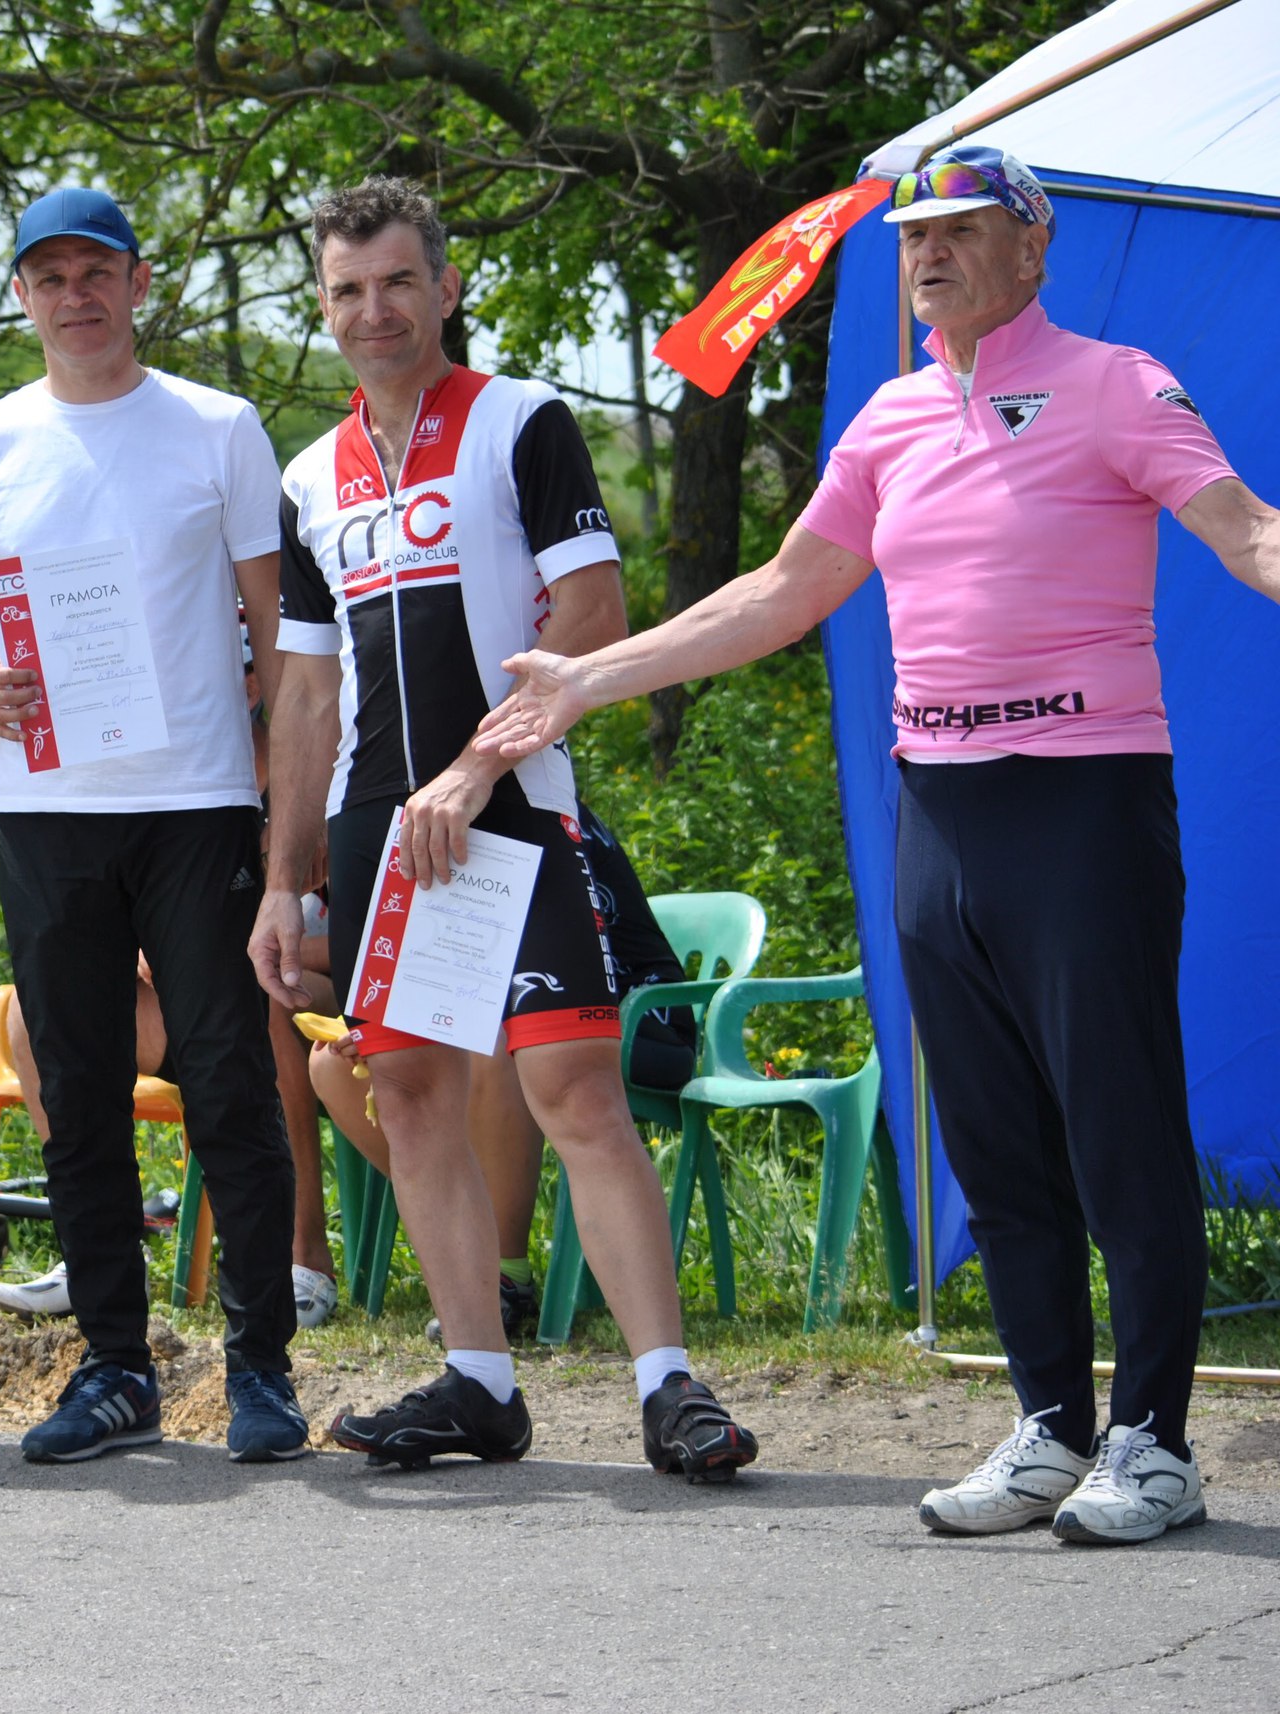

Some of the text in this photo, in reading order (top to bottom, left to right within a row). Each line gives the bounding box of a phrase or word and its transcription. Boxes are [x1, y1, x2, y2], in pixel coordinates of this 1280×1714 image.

[989, 392, 1050, 403] SANCHESKI
[342, 562, 381, 584] ROSTOV
[424, 546, 458, 561] CLUB
[50, 584, 121, 607] ГРАМОТА
[449, 869, 511, 896] РАМОТА
